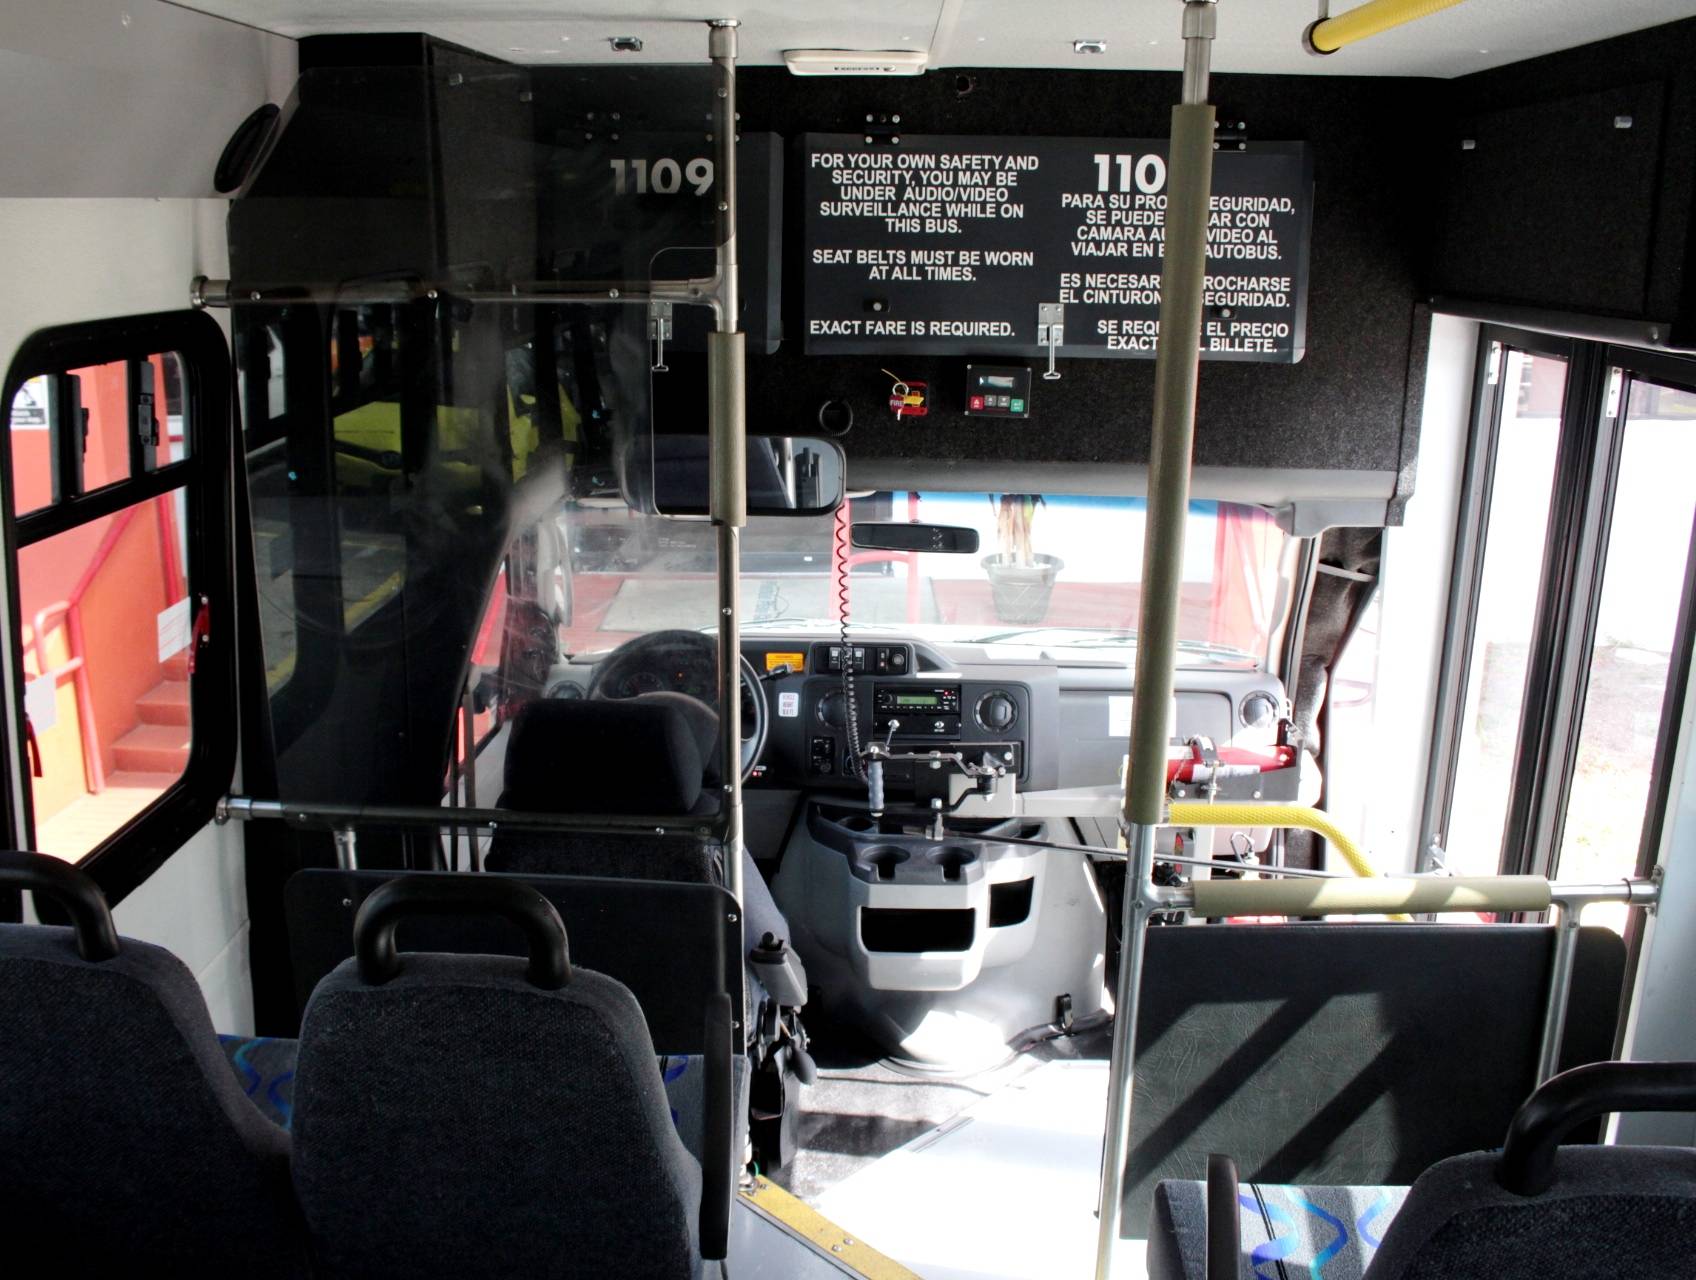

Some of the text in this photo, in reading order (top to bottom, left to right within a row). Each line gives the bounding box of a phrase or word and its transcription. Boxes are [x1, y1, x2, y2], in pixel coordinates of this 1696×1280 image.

[811, 153, 1039, 170] FOR YOUR OWN SAFETY AND
[610, 157, 714, 196] 1109
[832, 170, 1018, 186] SECURITY, YOU MAY BE
[1094, 154, 1166, 194] 110
[840, 186, 1008, 201] UNDER AUDIO/VIDEO
[820, 202, 1023, 218] SURVEILLANCE WHILE ON
[1062, 194, 1295, 214] PARA SU PRO EGURIDAD,
[885, 219, 962, 233] THIS BUS.
[1086, 211, 1106, 225] SE
[1236, 213, 1270, 227] CON
[1077, 227, 1146, 240] CAMARA
[1257, 229, 1277, 243] AL
[812, 250, 1034, 265] SEAT BELTS MUST BE WORN
[1071, 242, 1127, 256] VIAJAR
[1133, 243, 1153, 257] EN
[1204, 245, 1281, 259] AUTOBUS.
[869, 266, 976, 280] AT ALL TIMES.
[1060, 274, 1290, 291] ES NECESAR ROCHARSE
[1060, 289, 1079, 303] EL
[1204, 292, 1290, 307] EGURIDAD.
[810, 321, 1015, 336] EXACT FARE IS REQUIRED.
[1097, 320, 1119, 334] SE
[1206, 323, 1225, 336] EL
[1230, 323, 1288, 337] PRECIO
[1107, 336, 1277, 352] EXACT BILLETE.
